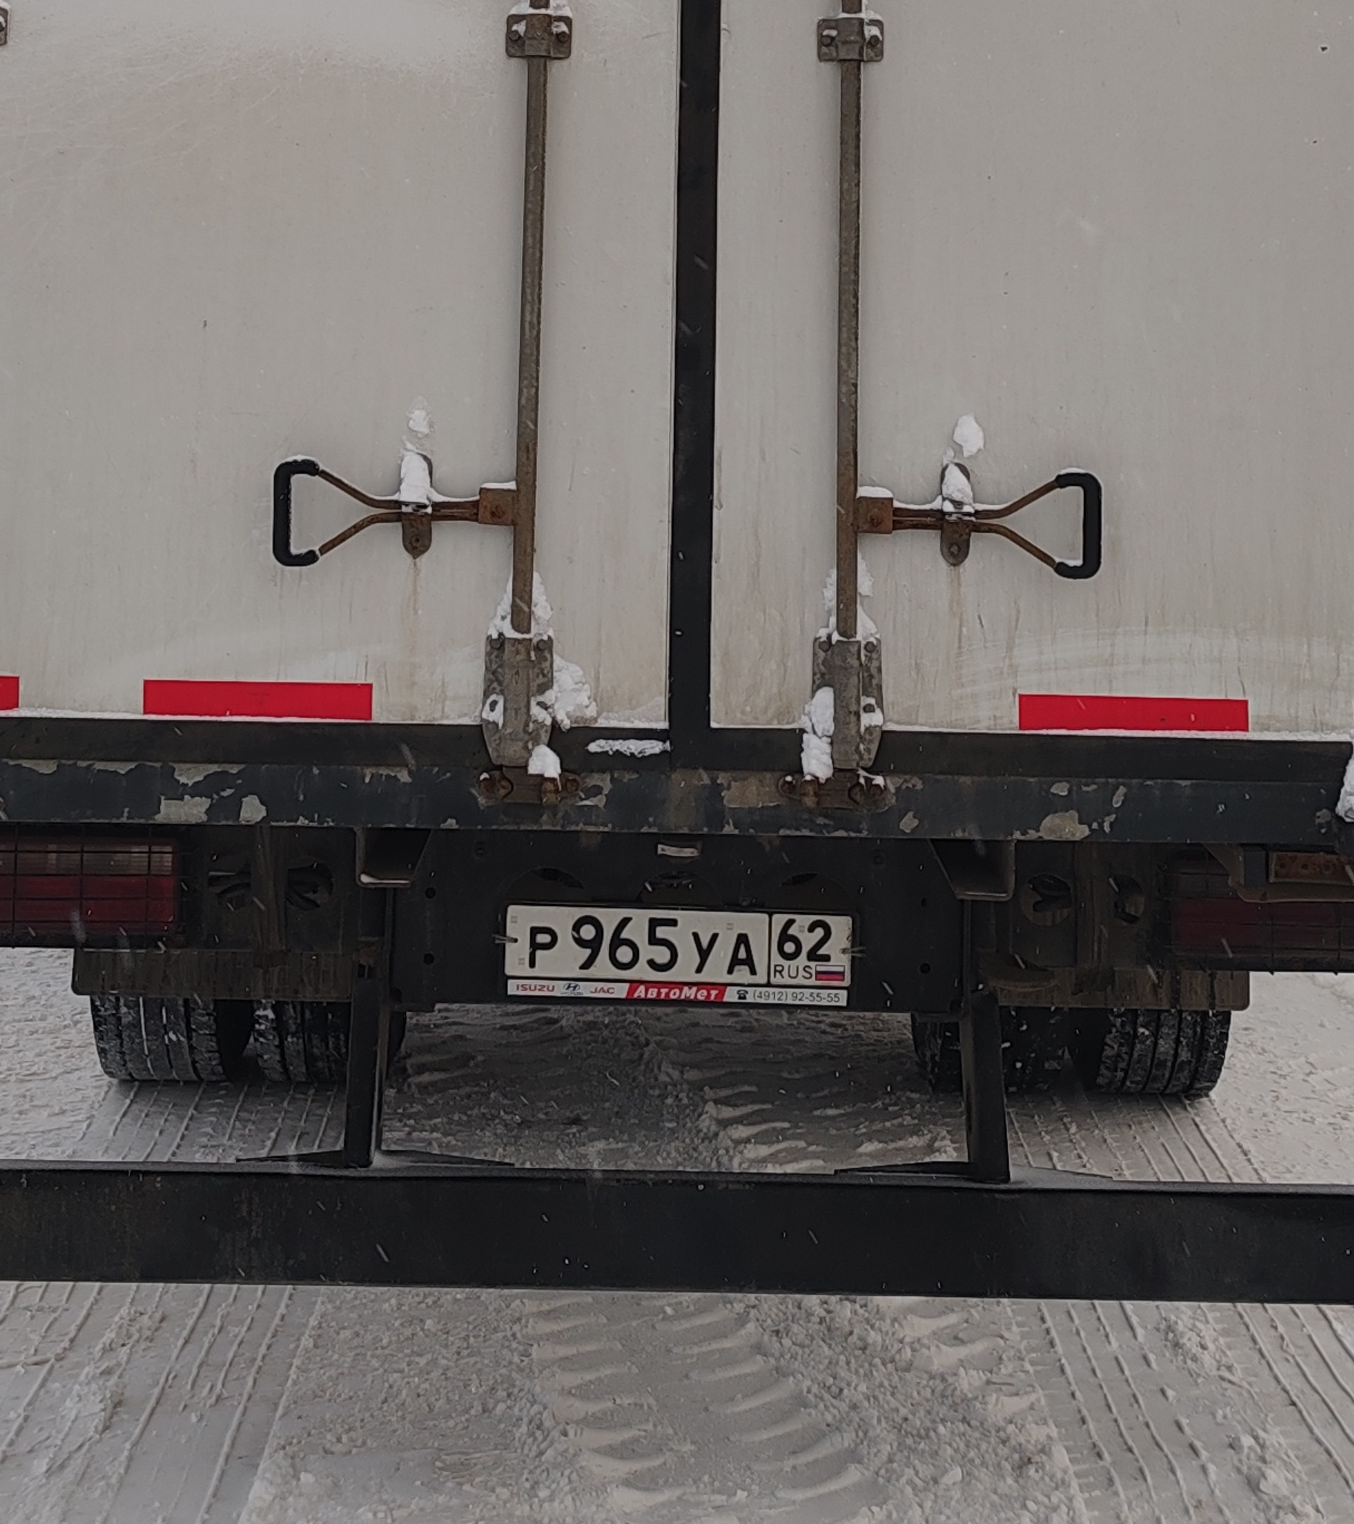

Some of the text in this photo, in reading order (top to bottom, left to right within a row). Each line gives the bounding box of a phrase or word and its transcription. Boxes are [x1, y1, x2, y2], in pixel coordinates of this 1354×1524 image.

[777, 918, 833, 963] 62
[773, 963, 814, 980] RUS
[516, 983, 556, 993] ISUZU
[590, 987, 615, 995] JAC
[753, 990, 841, 1003] (4912) 92-55-55
